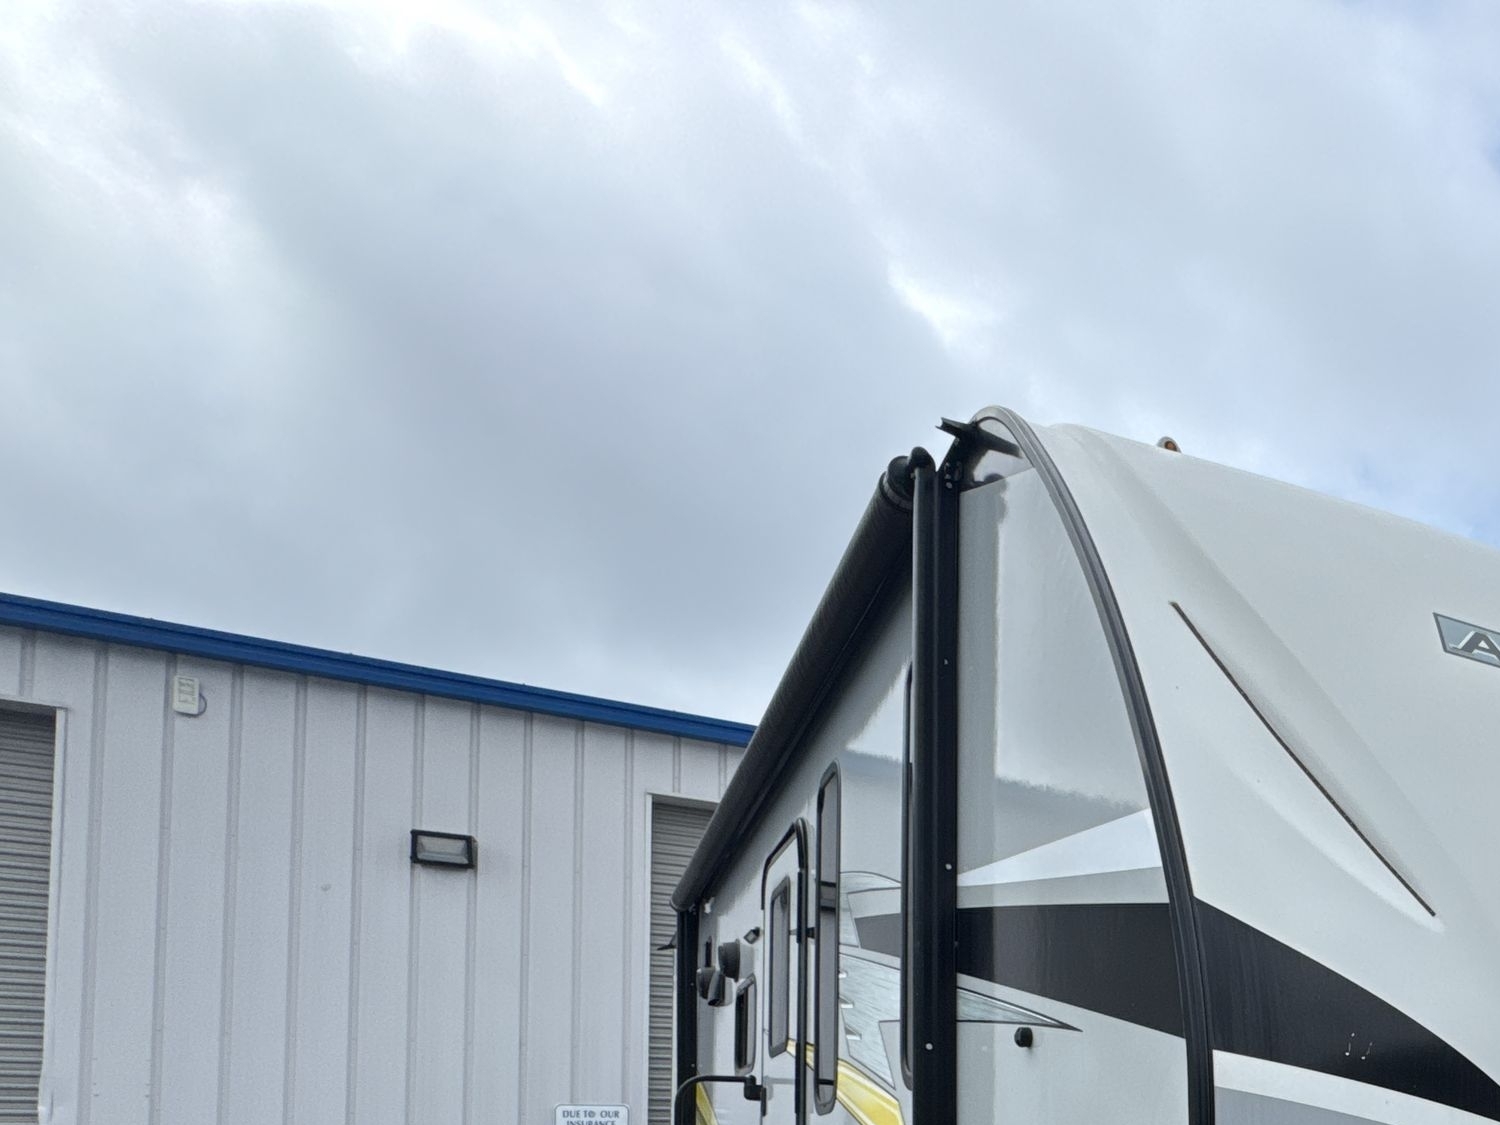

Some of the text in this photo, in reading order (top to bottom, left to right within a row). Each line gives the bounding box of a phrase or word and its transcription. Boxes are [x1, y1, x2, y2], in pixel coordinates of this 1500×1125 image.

[562, 1110, 620, 1119] DUE TO OUR
